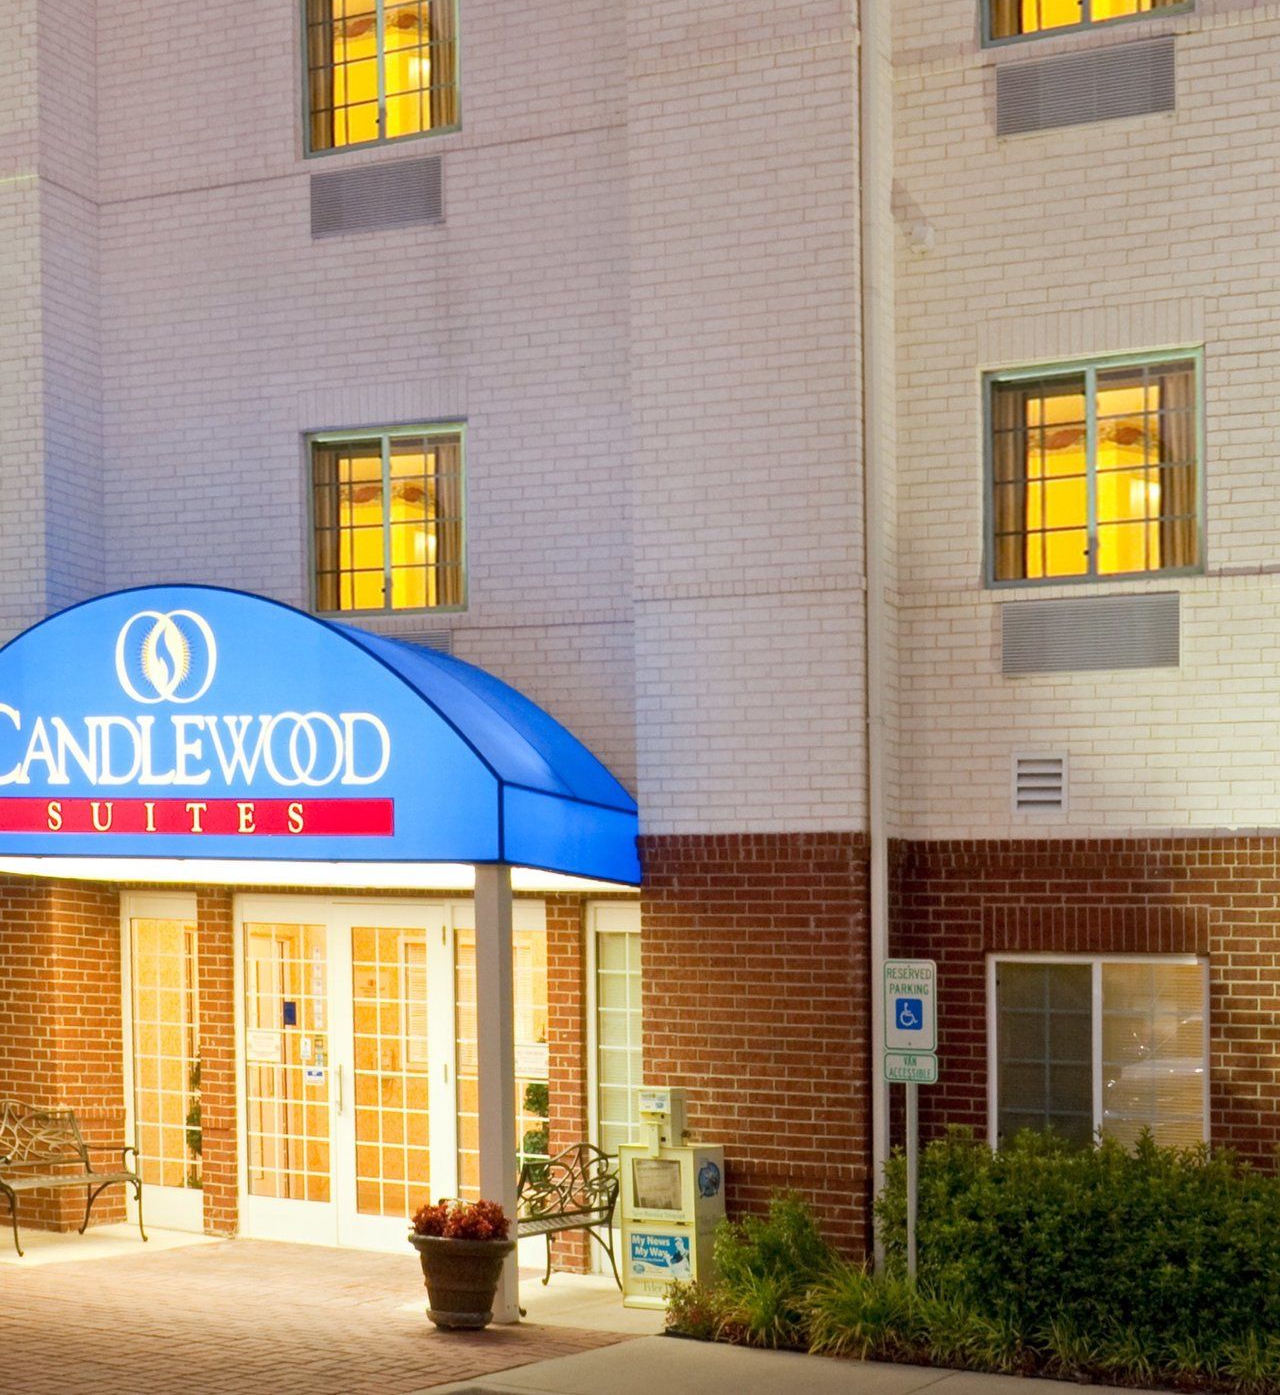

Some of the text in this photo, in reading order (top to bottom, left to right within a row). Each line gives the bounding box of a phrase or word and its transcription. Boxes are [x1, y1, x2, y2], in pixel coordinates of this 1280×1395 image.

[46, 801, 305, 834] SUITES
[886, 968, 931, 980] RESERVED
[889, 984, 929, 995] PARKING
[904, 1056, 916, 1065] VAN
[889, 1068, 931, 1079] ACCESSIBLE
[632, 1235, 670, 1246] My News
[635, 1246, 648, 1258] My
